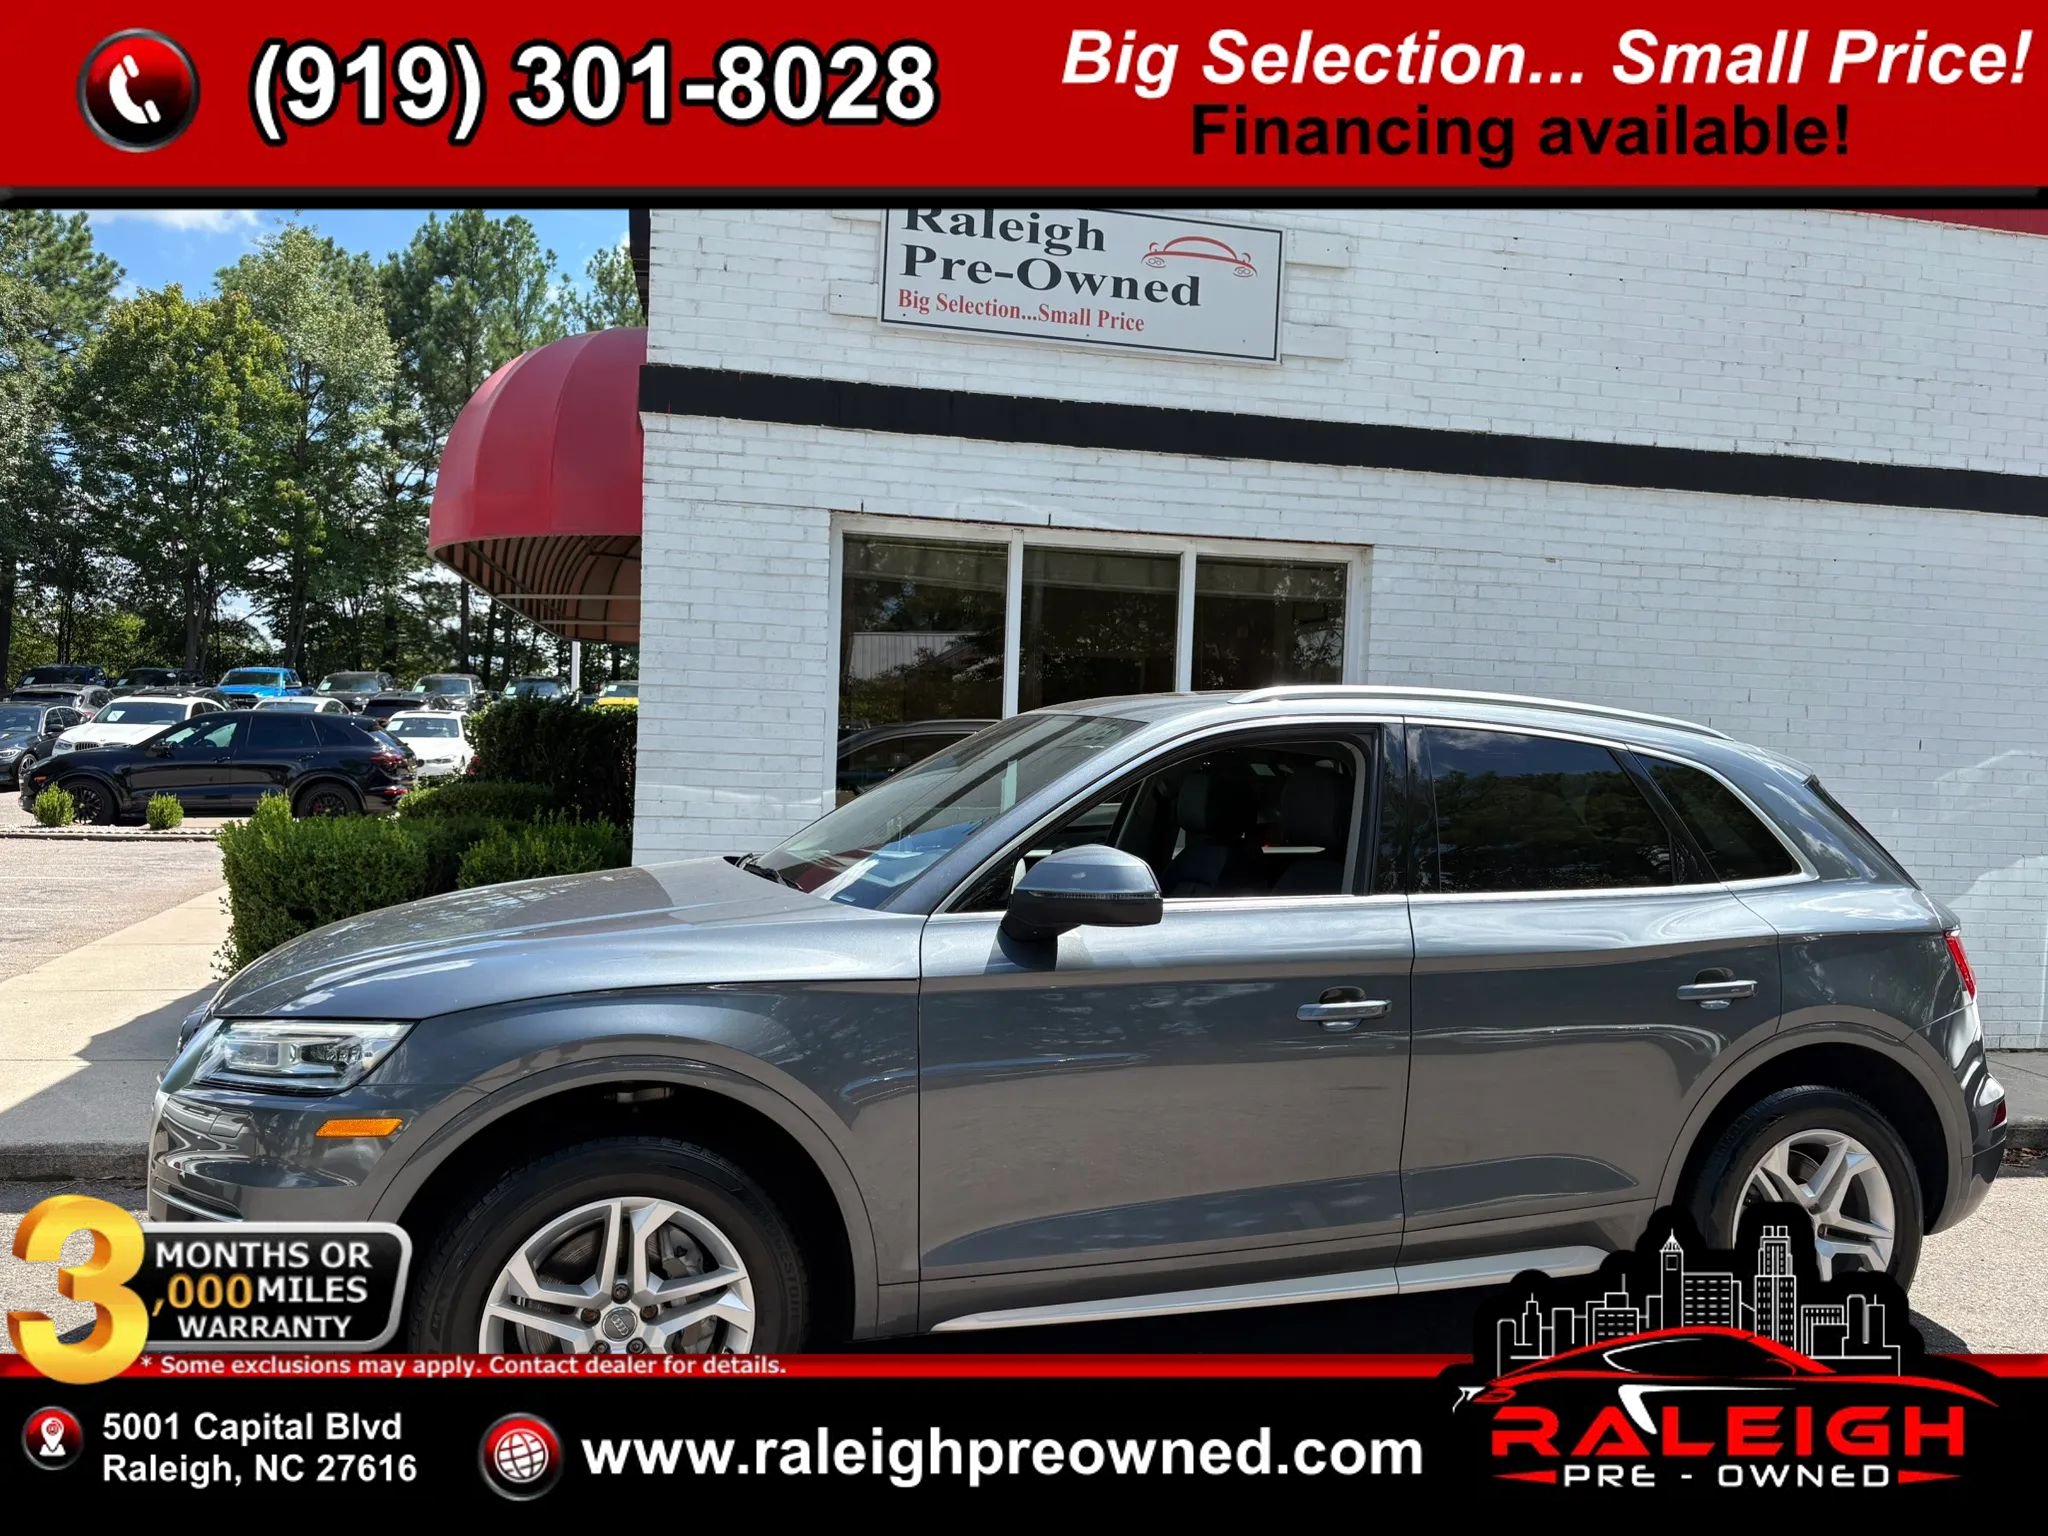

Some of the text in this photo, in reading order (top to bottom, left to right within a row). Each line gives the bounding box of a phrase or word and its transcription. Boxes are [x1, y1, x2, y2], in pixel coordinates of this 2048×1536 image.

[901, 208, 1106, 256] Raleigh
[900, 243, 1201, 307] Pre-Owned
[898, 288, 930, 315] Big
[1097, 309, 1145, 332] Price
